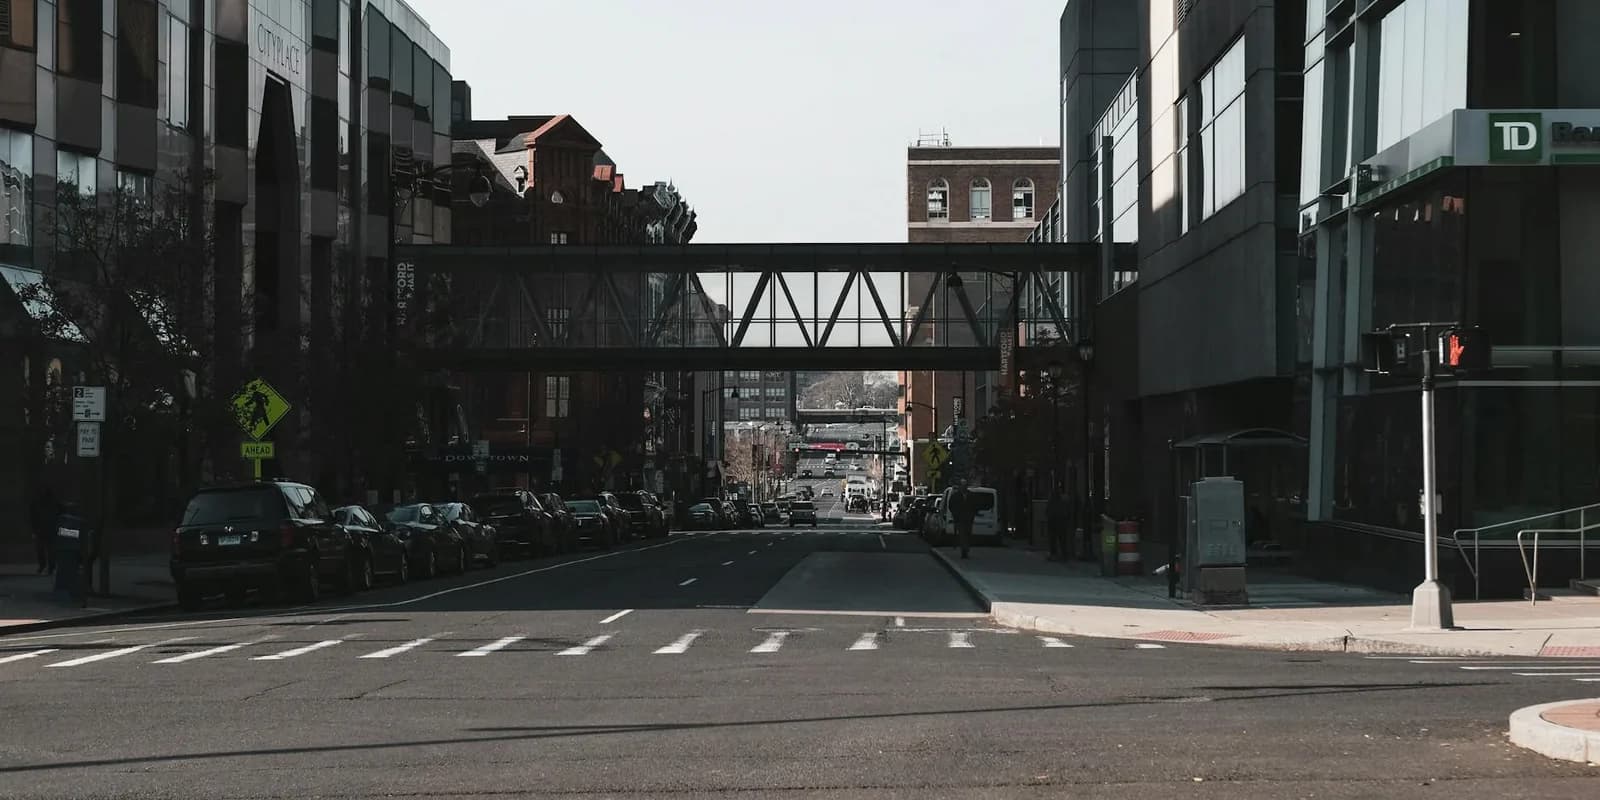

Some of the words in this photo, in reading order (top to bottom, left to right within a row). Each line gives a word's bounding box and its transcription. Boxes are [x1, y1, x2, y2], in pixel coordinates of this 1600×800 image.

[257, 23, 300, 75] CITYPLACE
[1494, 121, 1537, 151] TD
[245, 446, 271, 454] AHEAD
[445, 455, 529, 463] DOWTOWN
